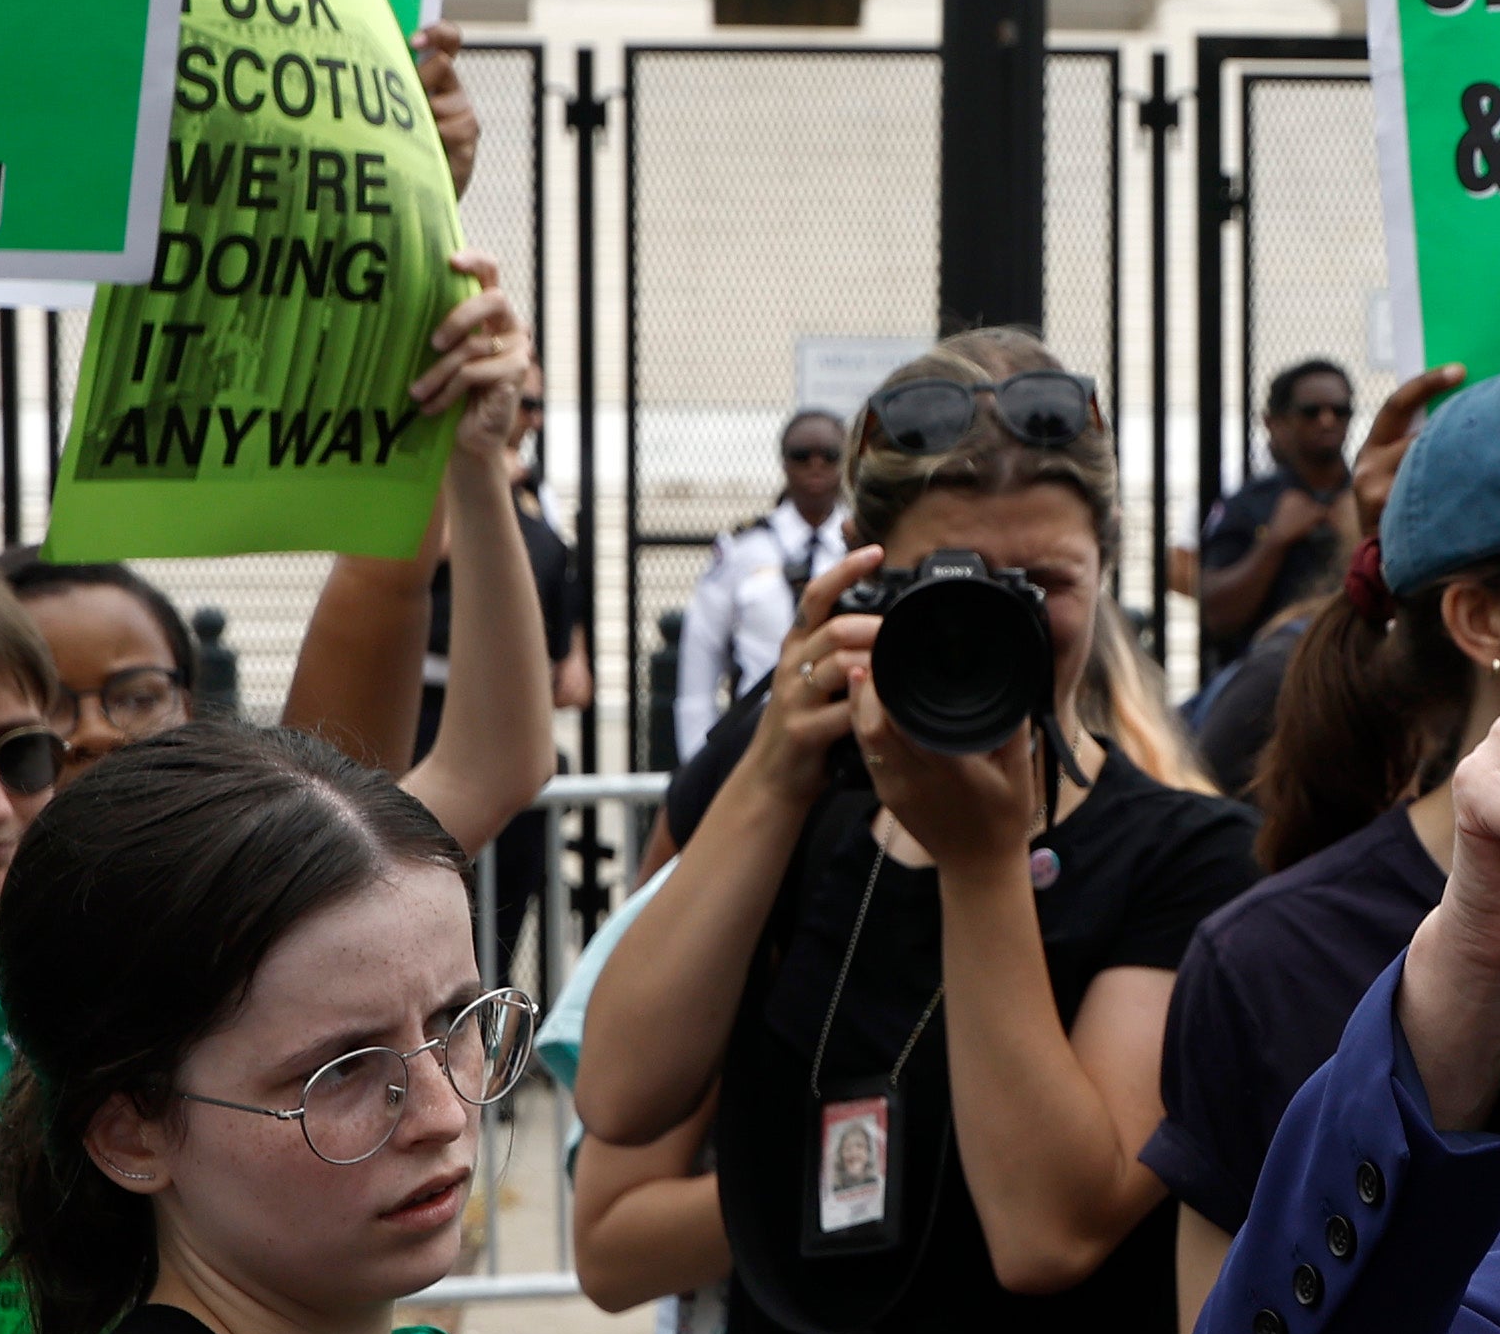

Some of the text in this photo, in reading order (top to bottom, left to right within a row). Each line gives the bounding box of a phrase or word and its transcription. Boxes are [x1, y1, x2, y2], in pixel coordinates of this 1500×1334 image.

[175, 48, 416, 130] SCOTUS
[169, 139, 392, 216] WE'RE
[150, 232, 390, 303] DOING
[131, 322, 209, 384] IT
[100, 406, 420, 469] ANYWAY
[932, 565, 973, 578] SONY
